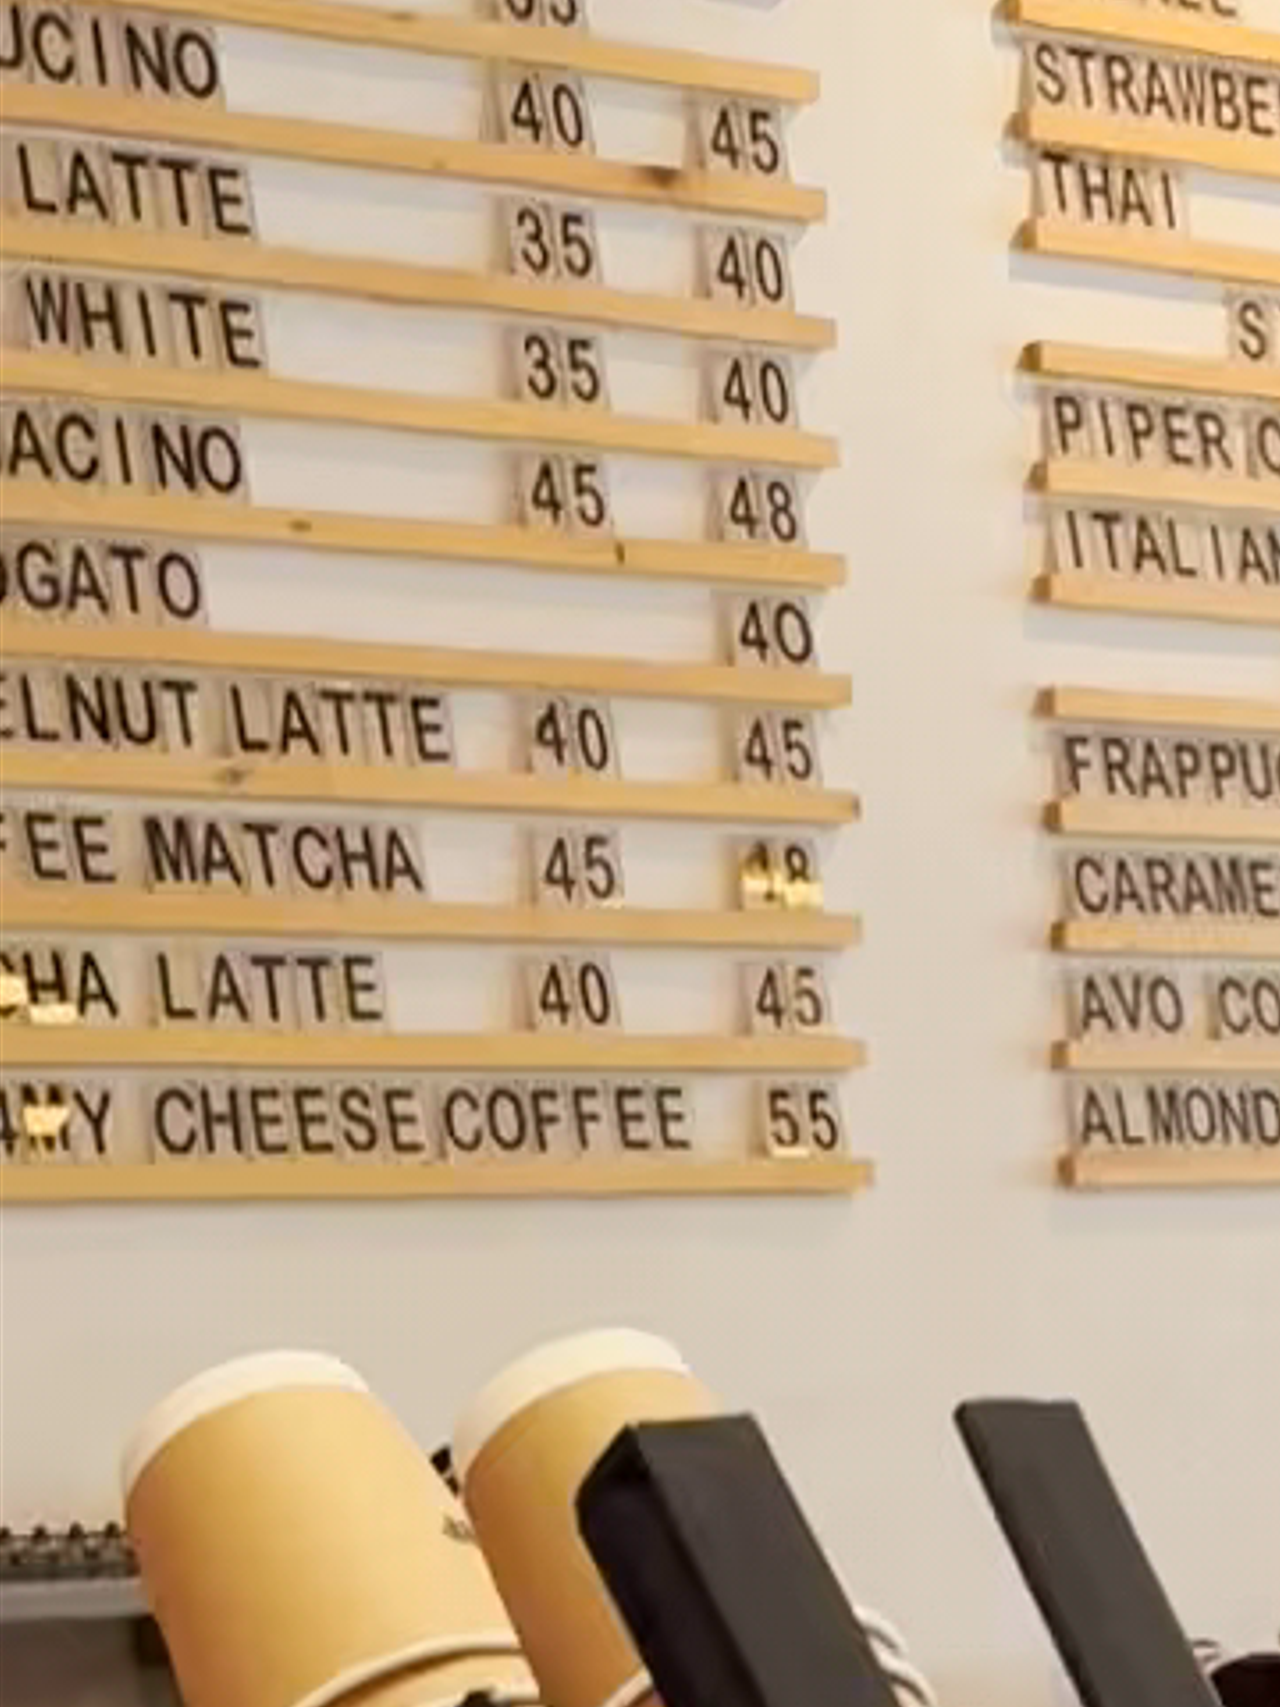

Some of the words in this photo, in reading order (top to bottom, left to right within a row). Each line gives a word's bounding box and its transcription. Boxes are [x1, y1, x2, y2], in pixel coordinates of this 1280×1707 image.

[509, 79, 586, 148] 40
[710, 107, 780, 175] 45
[15, 142, 251, 235] LATTE
[516, 208, 595, 279] 35
[717, 236, 784, 301] 40
[1041, 155, 1177, 229] THAI
[24, 274, 264, 370] WHITE
[523, 334, 601, 402] 35
[723, 359, 788, 425] 40
[7, 405, 243, 496] ACINO
[531, 461, 606, 529] 45
[728, 478, 799, 545] 48
[1054, 396, 1232, 470] PIPER
[0, 542, 201, 619] GATO
[739, 601, 814, 666] 40
[229, 684, 451, 765] LATTE
[535, 703, 609, 771] 40
[745, 717, 813, 782] 45
[144, 817, 424, 895] MATCHA
[545, 834, 617, 901] 45
[157, 951, 384, 1022] LATTE
[538, 960, 611, 1027] 40
[755, 966, 822, 1027] 45
[1080, 974, 1184, 1035] AVO
[154, 1088, 425, 1154] CHEESE
[443, 1087, 690, 1151] COFFEE
[768, 1087, 839, 1153] 55
